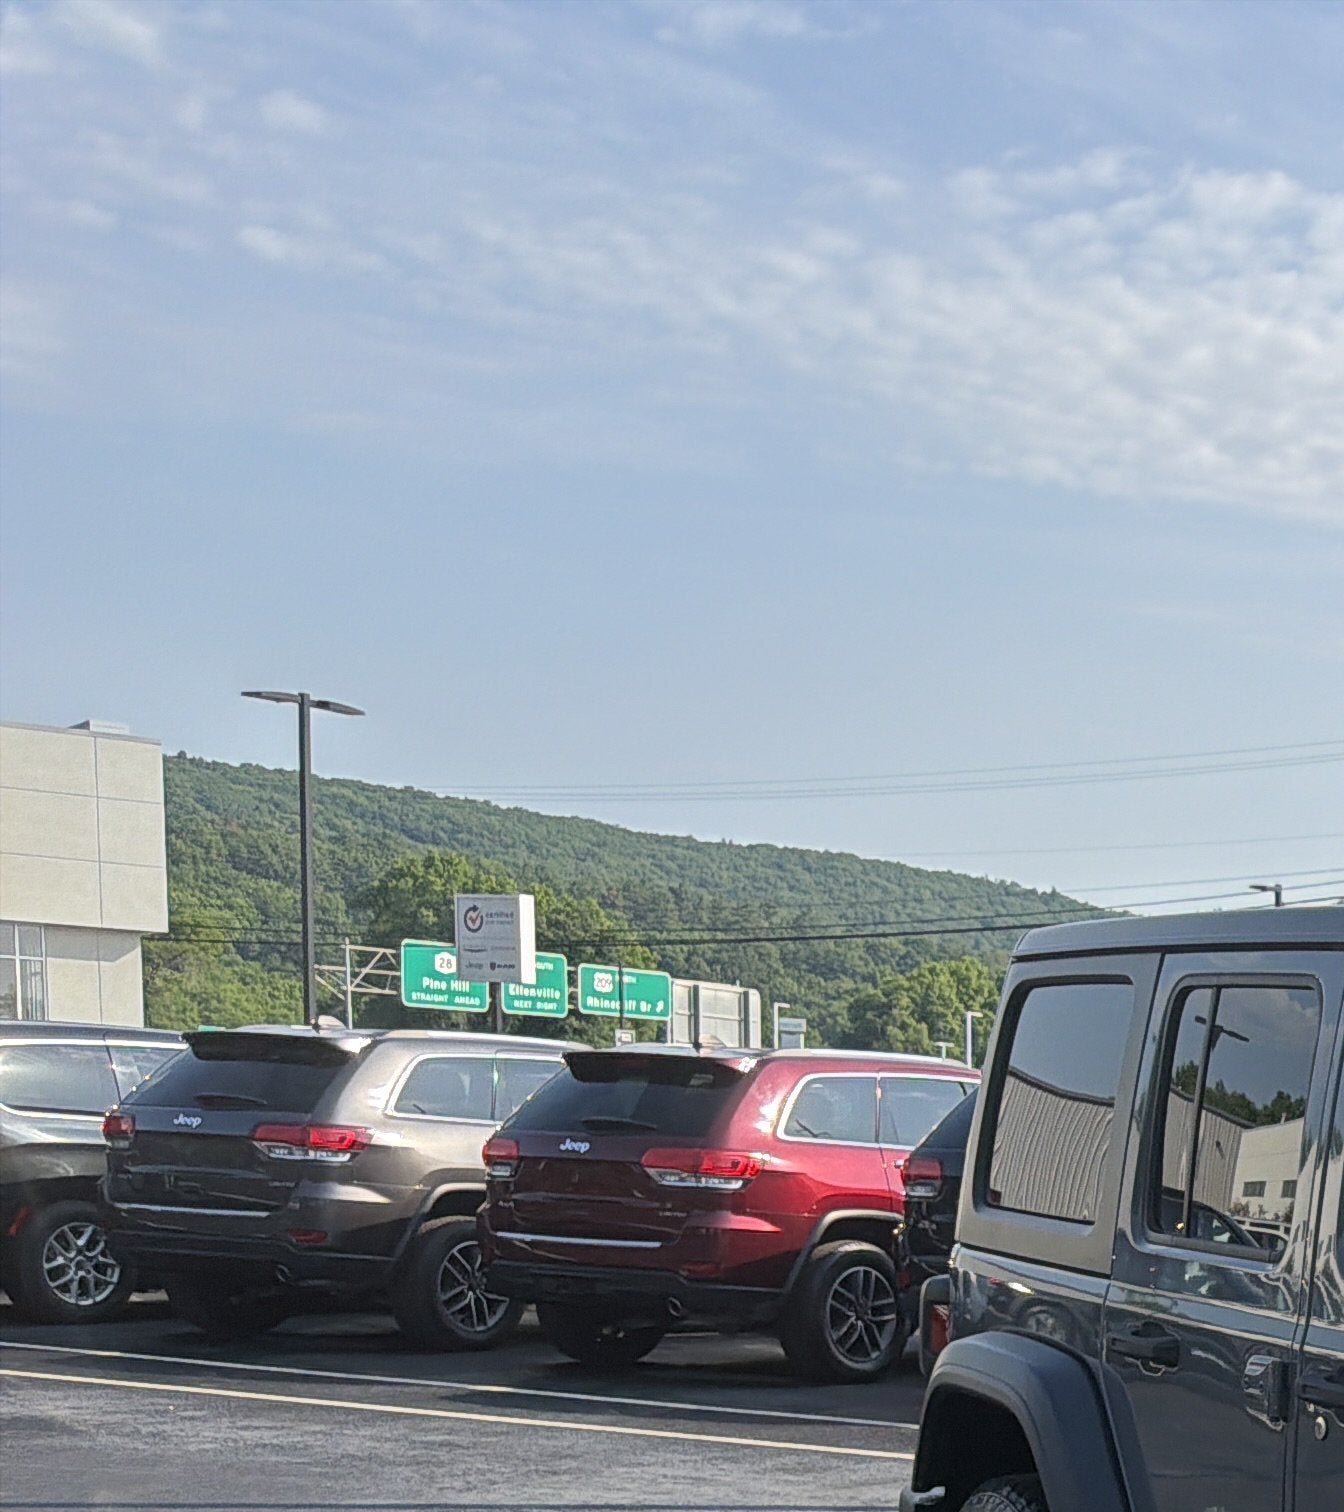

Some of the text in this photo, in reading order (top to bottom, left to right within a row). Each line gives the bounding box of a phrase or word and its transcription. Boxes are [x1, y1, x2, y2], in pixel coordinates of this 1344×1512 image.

[439, 957, 453, 969] 28
[422, 976, 470, 993] Pine Hill
[411, 991, 481, 1006] STRAIGHT AHEAD
[513, 999, 558, 1011] NEXT RIGHT
[173, 1113, 202, 1129] Jeep
[559, 1138, 590, 1154] Jeep
